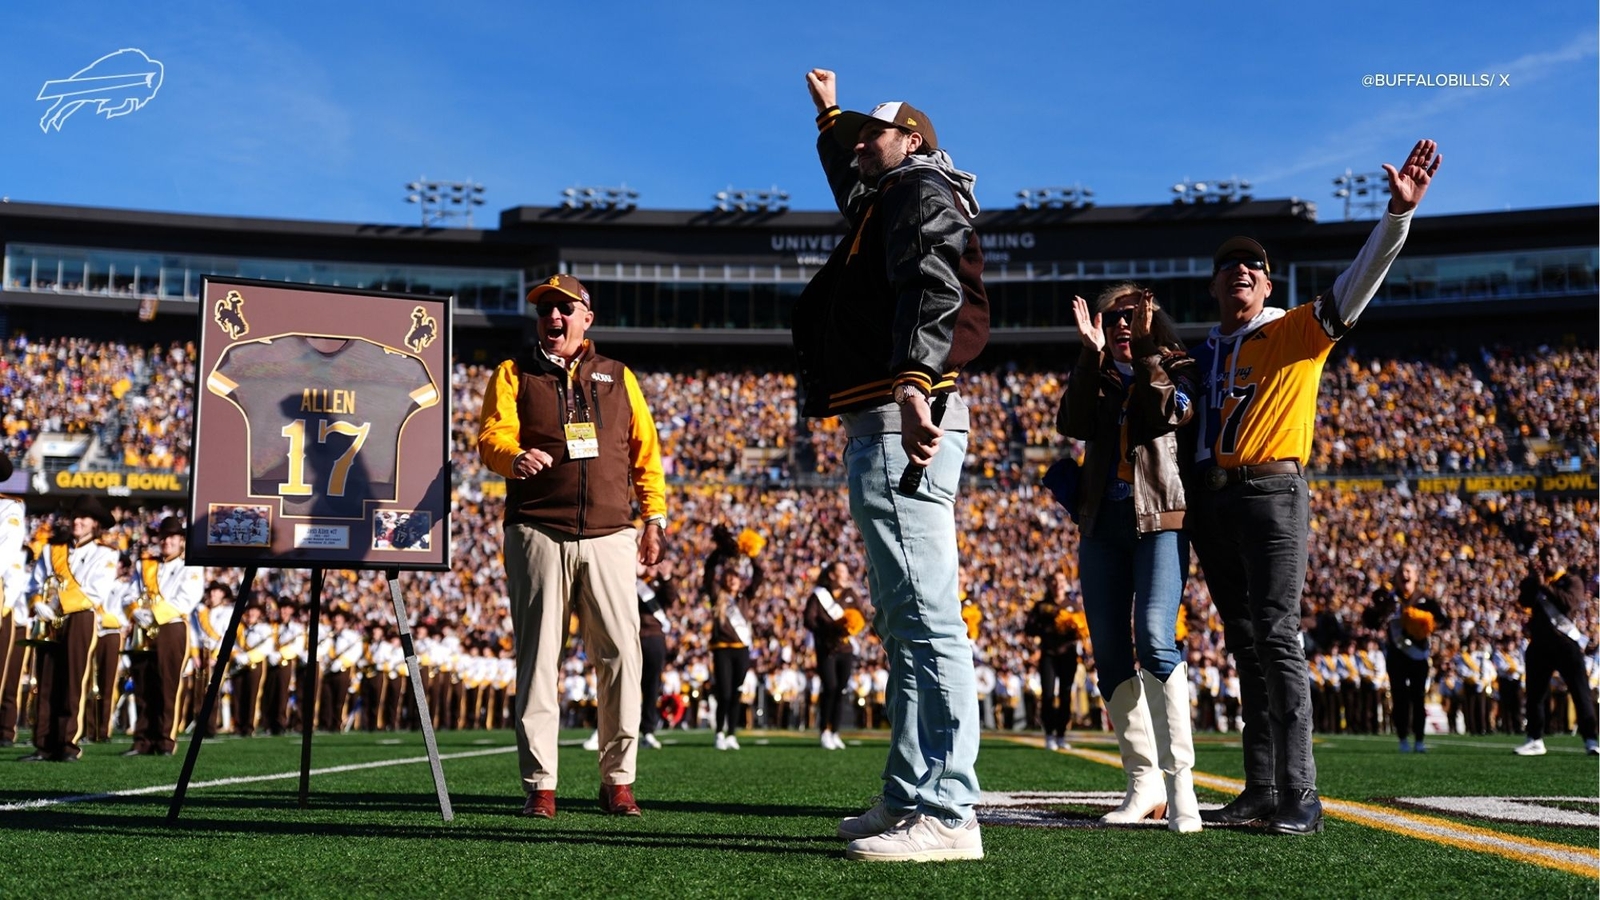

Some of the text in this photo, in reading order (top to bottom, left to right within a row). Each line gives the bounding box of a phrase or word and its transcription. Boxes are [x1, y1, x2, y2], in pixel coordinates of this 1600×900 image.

[771, 232, 1036, 251] UNIVE MING
[300, 388, 355, 414] ALLEN
[278, 419, 371, 497] 17
[56, 471, 181, 490] GATOR BOWL
[1418, 475, 1597, 492] NEW MEXICO BOWL
